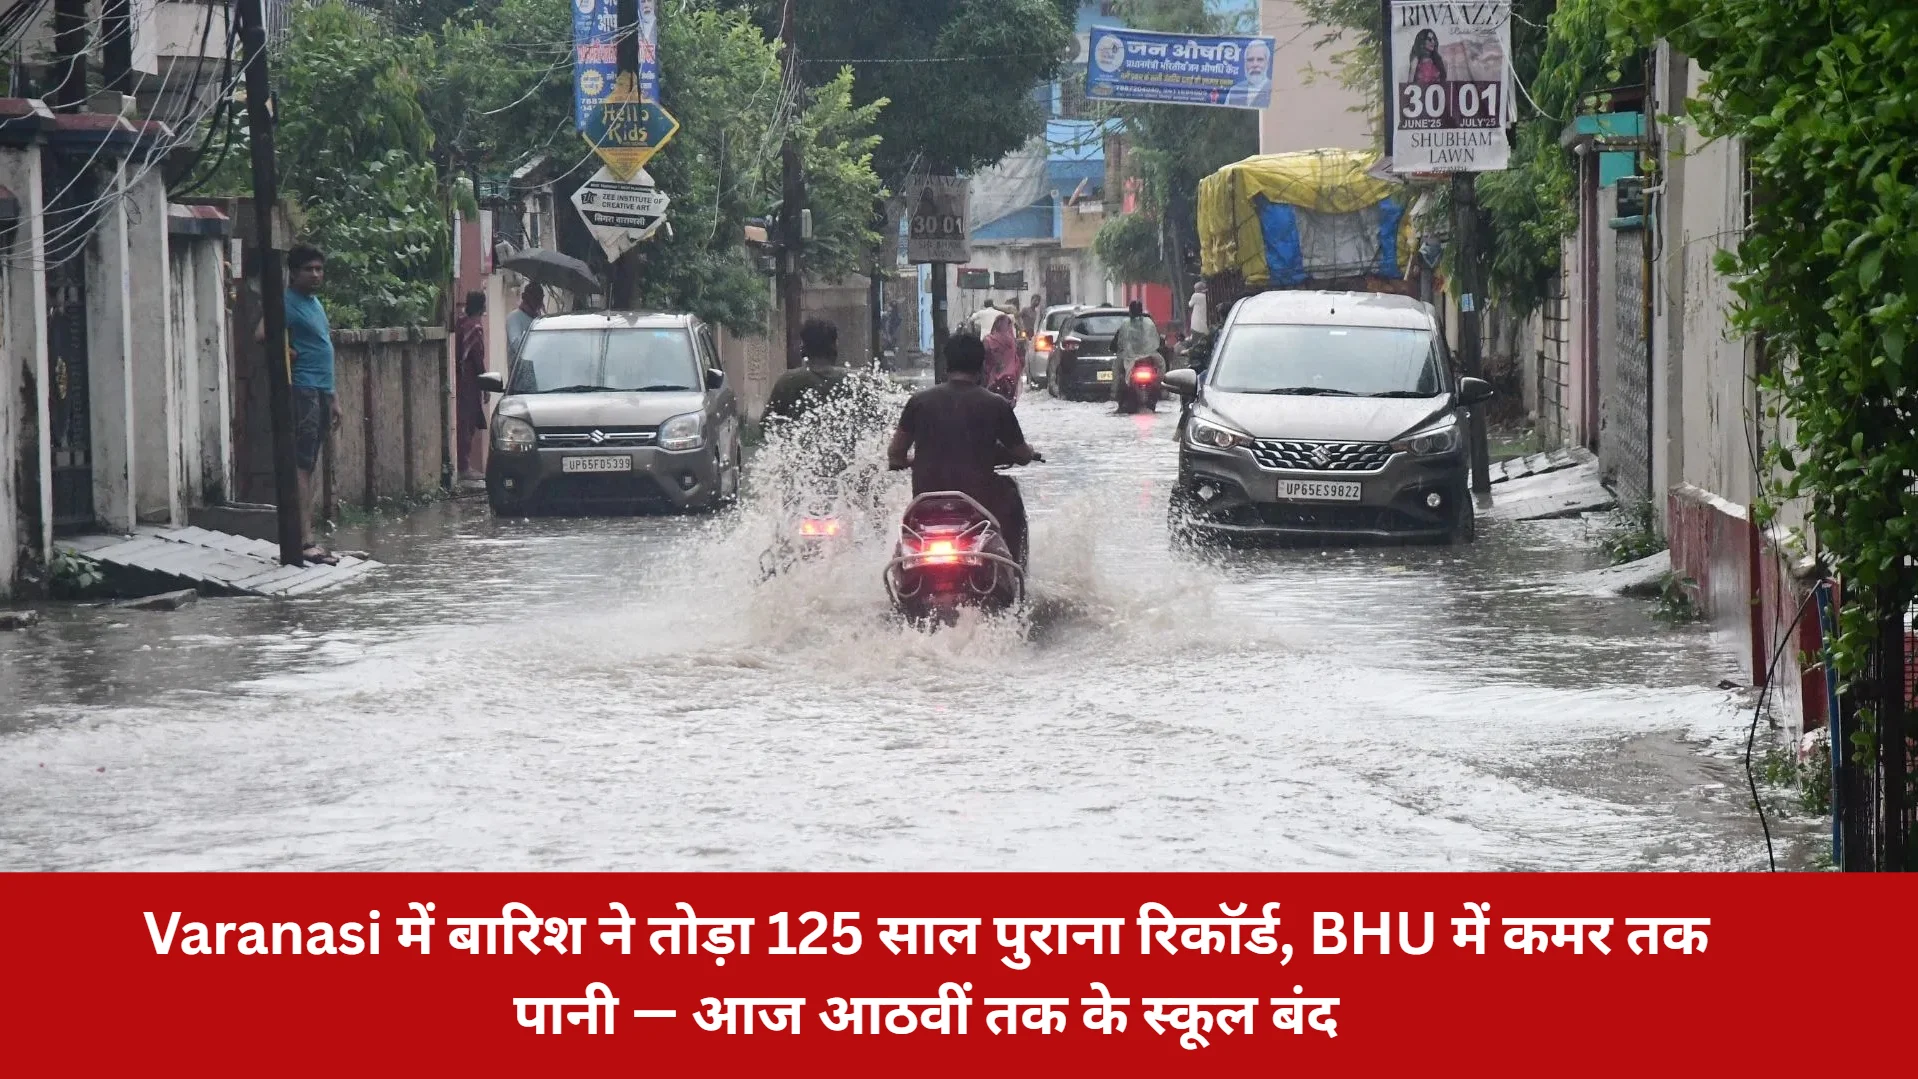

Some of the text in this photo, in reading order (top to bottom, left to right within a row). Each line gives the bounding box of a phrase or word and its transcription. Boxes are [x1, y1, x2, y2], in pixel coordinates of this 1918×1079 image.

[1401, 3, 1499, 26] RIWAAZZ
[1127, 40, 1168, 57] जन
[1403, 83, 1496, 118] 30 01
[602, 103, 649, 124] Hello
[1402, 118, 1496, 128] JUNE'25 JULY'25
[608, 124, 648, 144] Kids
[1411, 131, 1492, 148] SHUBHAM
[1429, 148, 1475, 163] LAWN
[602, 193, 616, 201] ZEE
[617, 195, 652, 204] INSTITUTE
[602, 201, 635, 210] CREATIVE
[914, 215, 964, 234] 30 01
[569, 458, 630, 470] UP65FD5399
[1286, 483, 1359, 498] UP65ES9822
